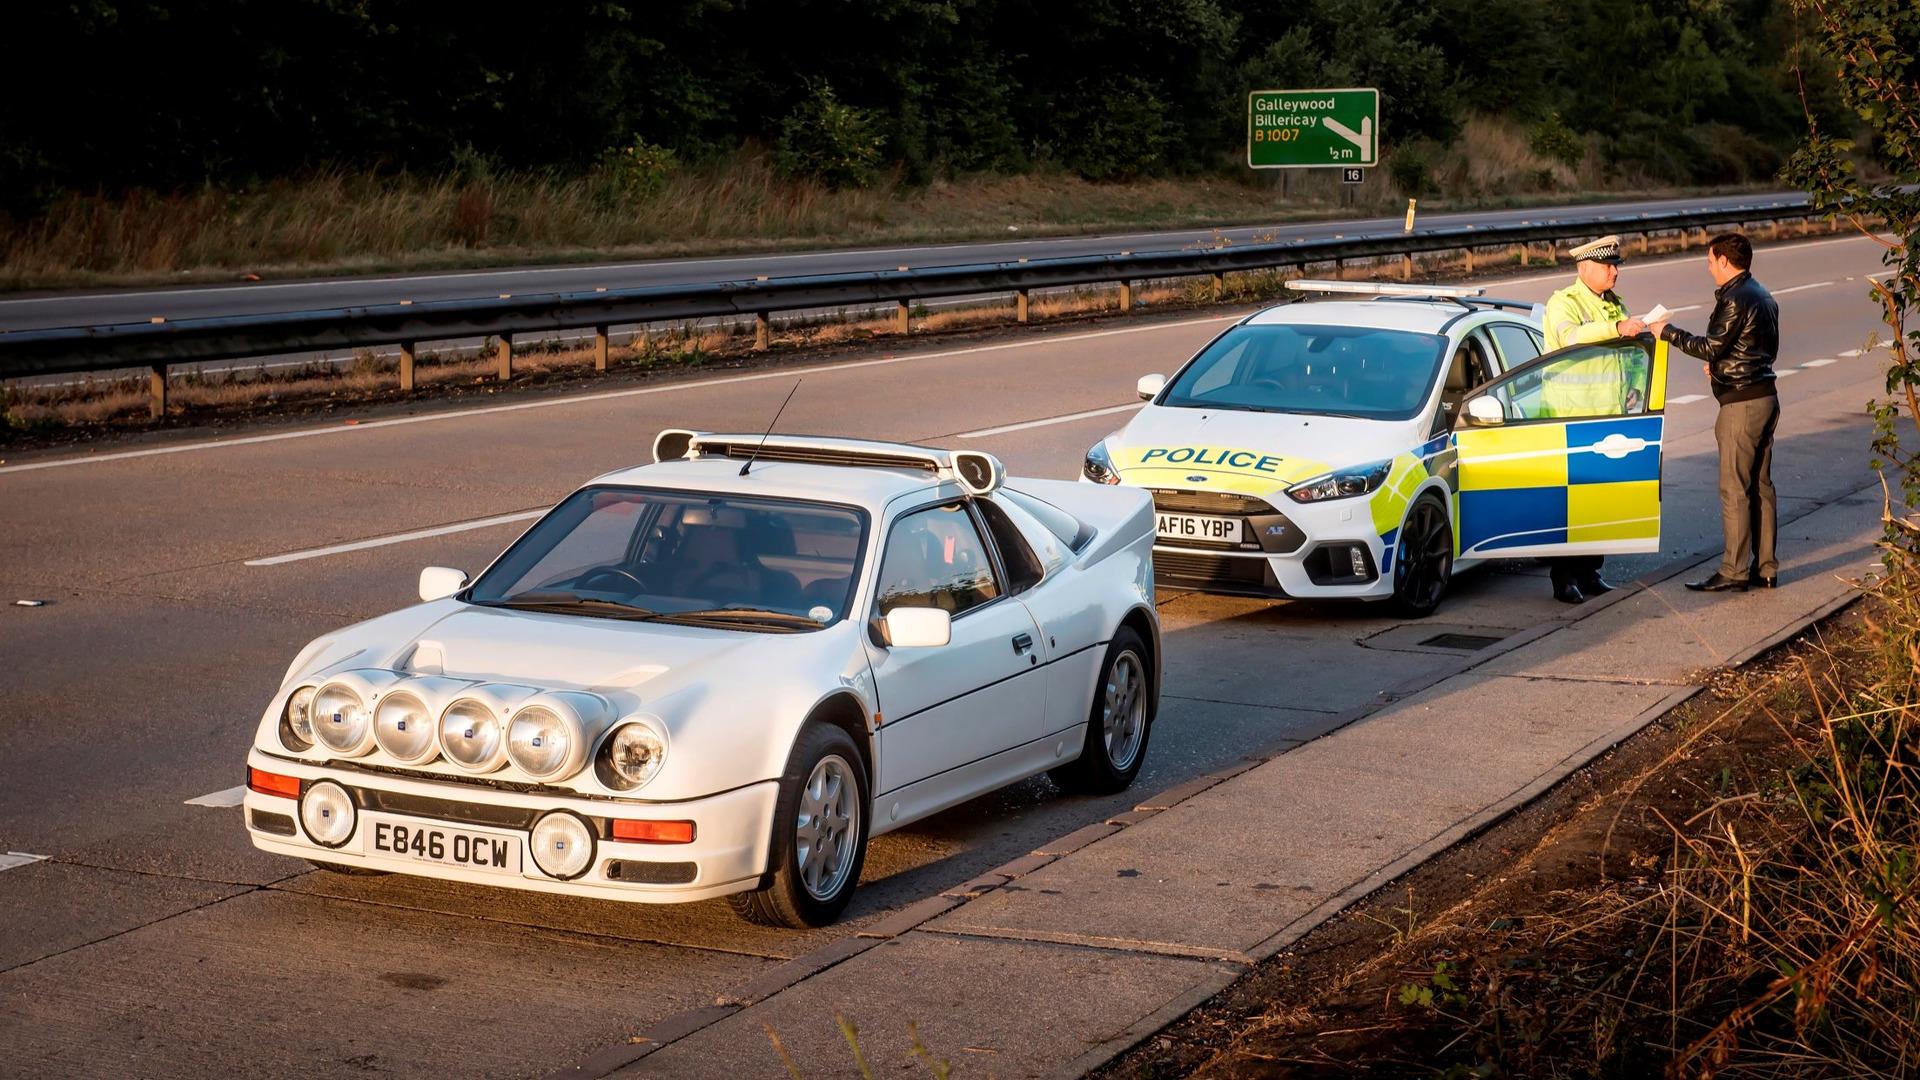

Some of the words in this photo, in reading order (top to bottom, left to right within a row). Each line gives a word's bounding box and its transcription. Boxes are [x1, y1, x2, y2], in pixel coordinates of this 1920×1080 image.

[1256, 97, 1335, 112] Galleywood
[1255, 114, 1317, 127] Billericay
[1347, 170, 1359, 180] 16
[1140, 447, 1283, 472] POLICE
[1158, 516, 1195, 535] AF16
[1201, 519, 1234, 538] YBP
[375, 822, 444, 859] E846
[453, 834, 508, 868] OCW
